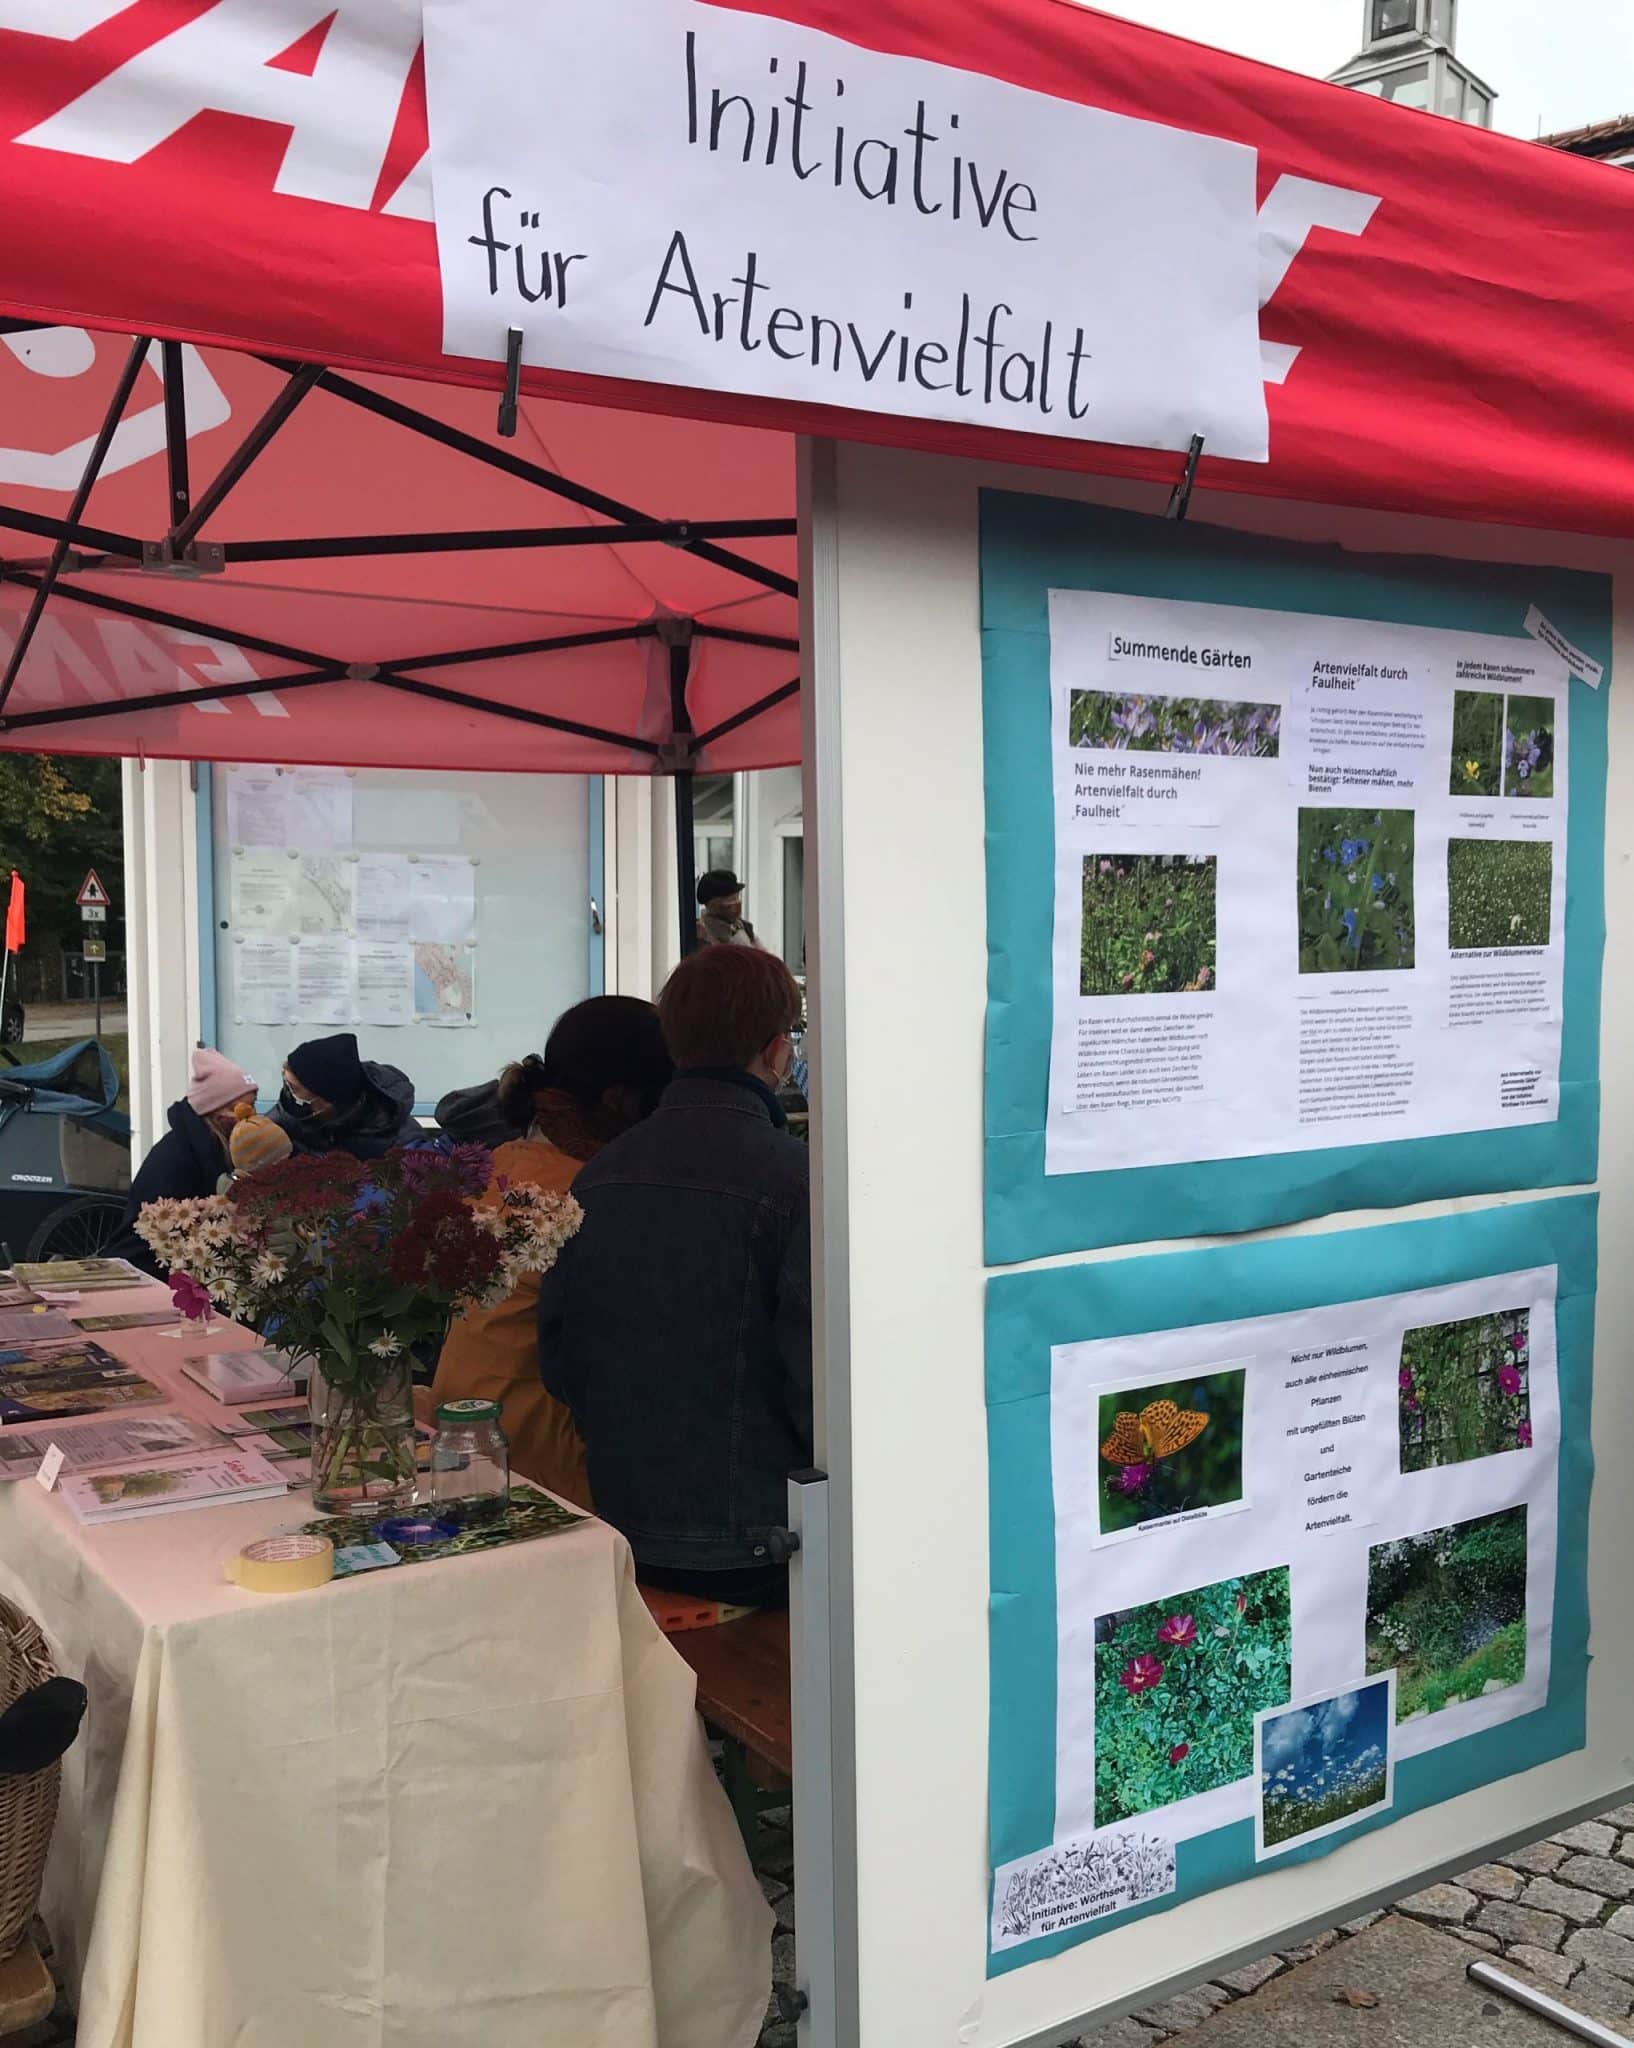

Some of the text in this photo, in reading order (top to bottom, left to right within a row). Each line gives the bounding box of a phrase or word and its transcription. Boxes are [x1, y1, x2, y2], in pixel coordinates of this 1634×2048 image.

[684, 30, 1039, 243] Initiative
[467, 186, 588, 309] für
[644, 230, 1093, 420] Artenvielfalt
[1114, 637, 1252, 668] Summende Gärten
[1313, 661, 1408, 680] Artenvielfalt durch
[1075, 763, 1201, 780] Nie mehr Rasenmähen!
[1324, 765, 1342, 775] auch
[1075, 784, 1178, 799] Artenvielfalt durch
[87, 908, 99, 918] 3x
[1291, 1352, 1311, 1364] Nicht
[1312, 1351, 1324, 1360] nur
[1284, 1364, 1368, 1389] auch alle einheimischen
[1311, 1394, 1342, 1407] Pflanzen
[1286, 1427, 1299, 1437] mit
[1342, 1413, 1366, 1425] Blüten
[1320, 1444, 1335, 1454] und
[1304, 1465, 1352, 1482] Gartenteiche
[1336, 1490, 1348, 1499] die
[1032, 1900, 1078, 1921] Initiative:
[1041, 1901, 1117, 1932] für Artenvielfalt
